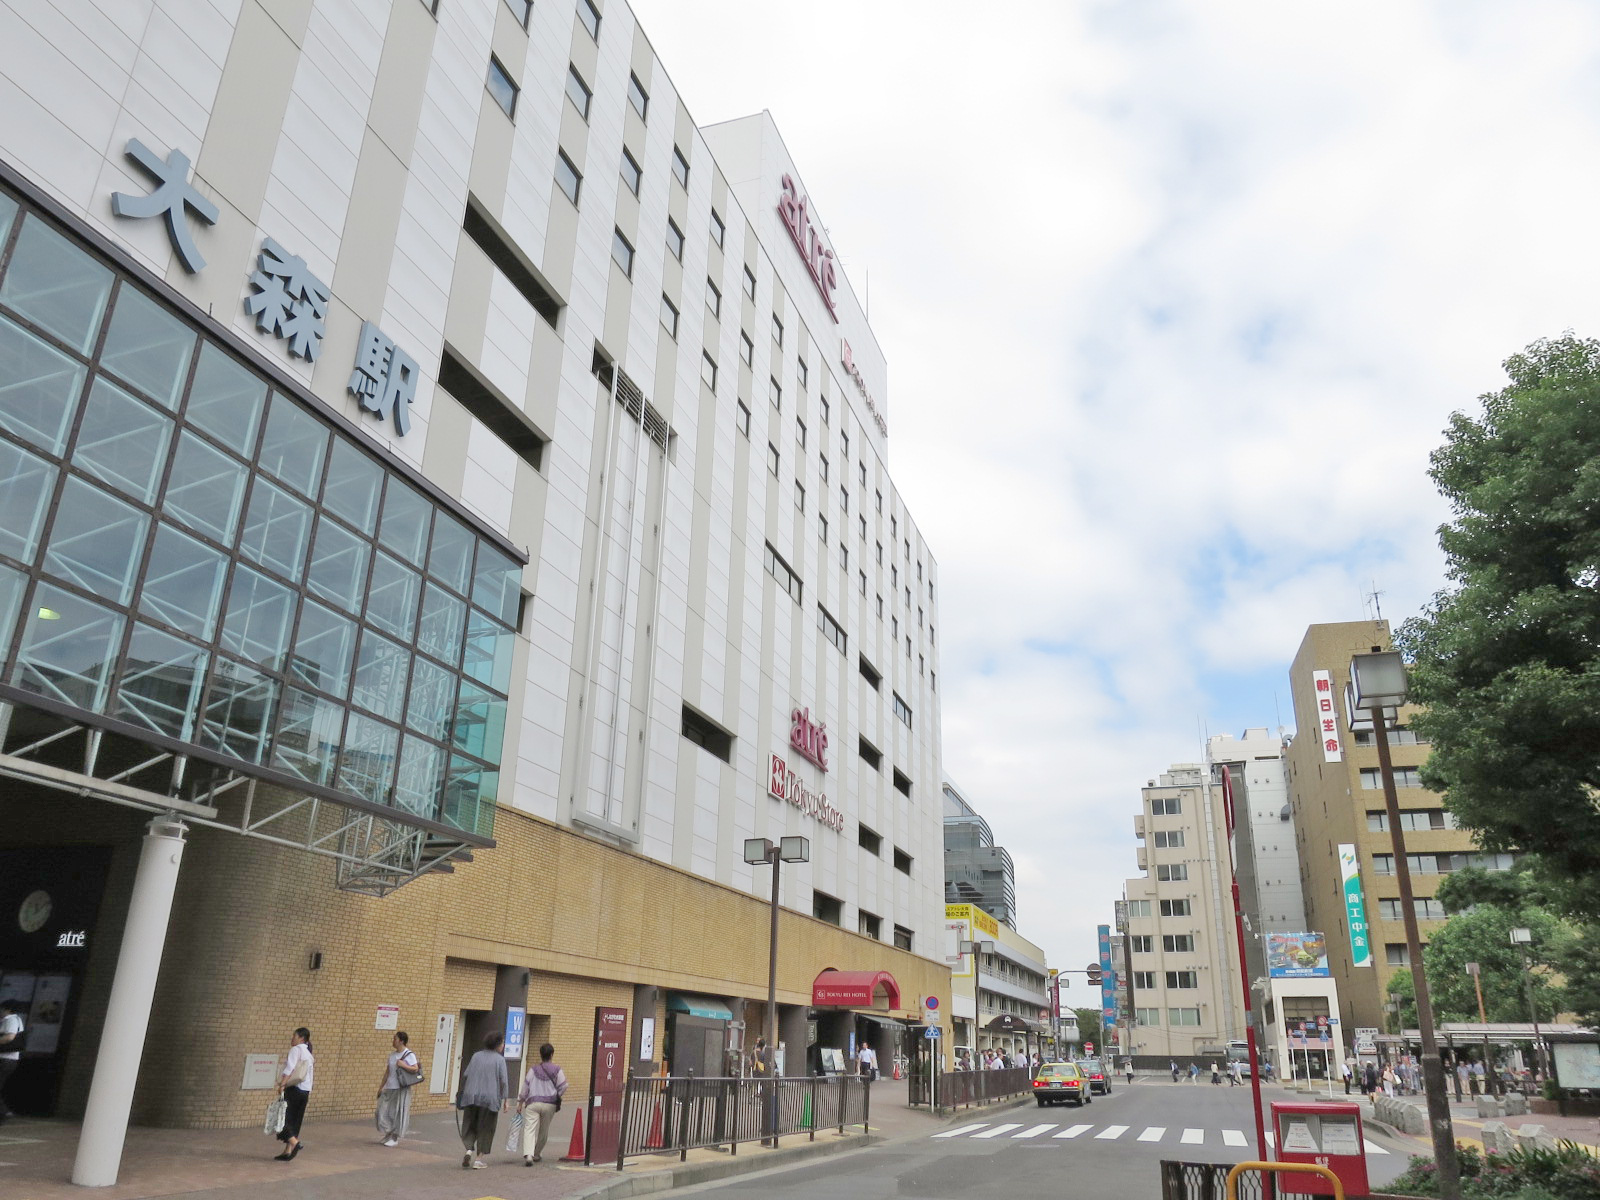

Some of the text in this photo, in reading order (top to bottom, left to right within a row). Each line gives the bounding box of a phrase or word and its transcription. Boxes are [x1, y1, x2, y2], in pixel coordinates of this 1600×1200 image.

[777, 172, 838, 322] atré
[111, 137, 420, 437] 大森駅
[790, 707, 829, 770] atré
[1316, 679, 1338, 752] 朝日生命
[786, 769, 844, 831] Tokyu Store
[57, 931, 85, 946] atré
[1348, 893, 1365, 947] 商工中金
